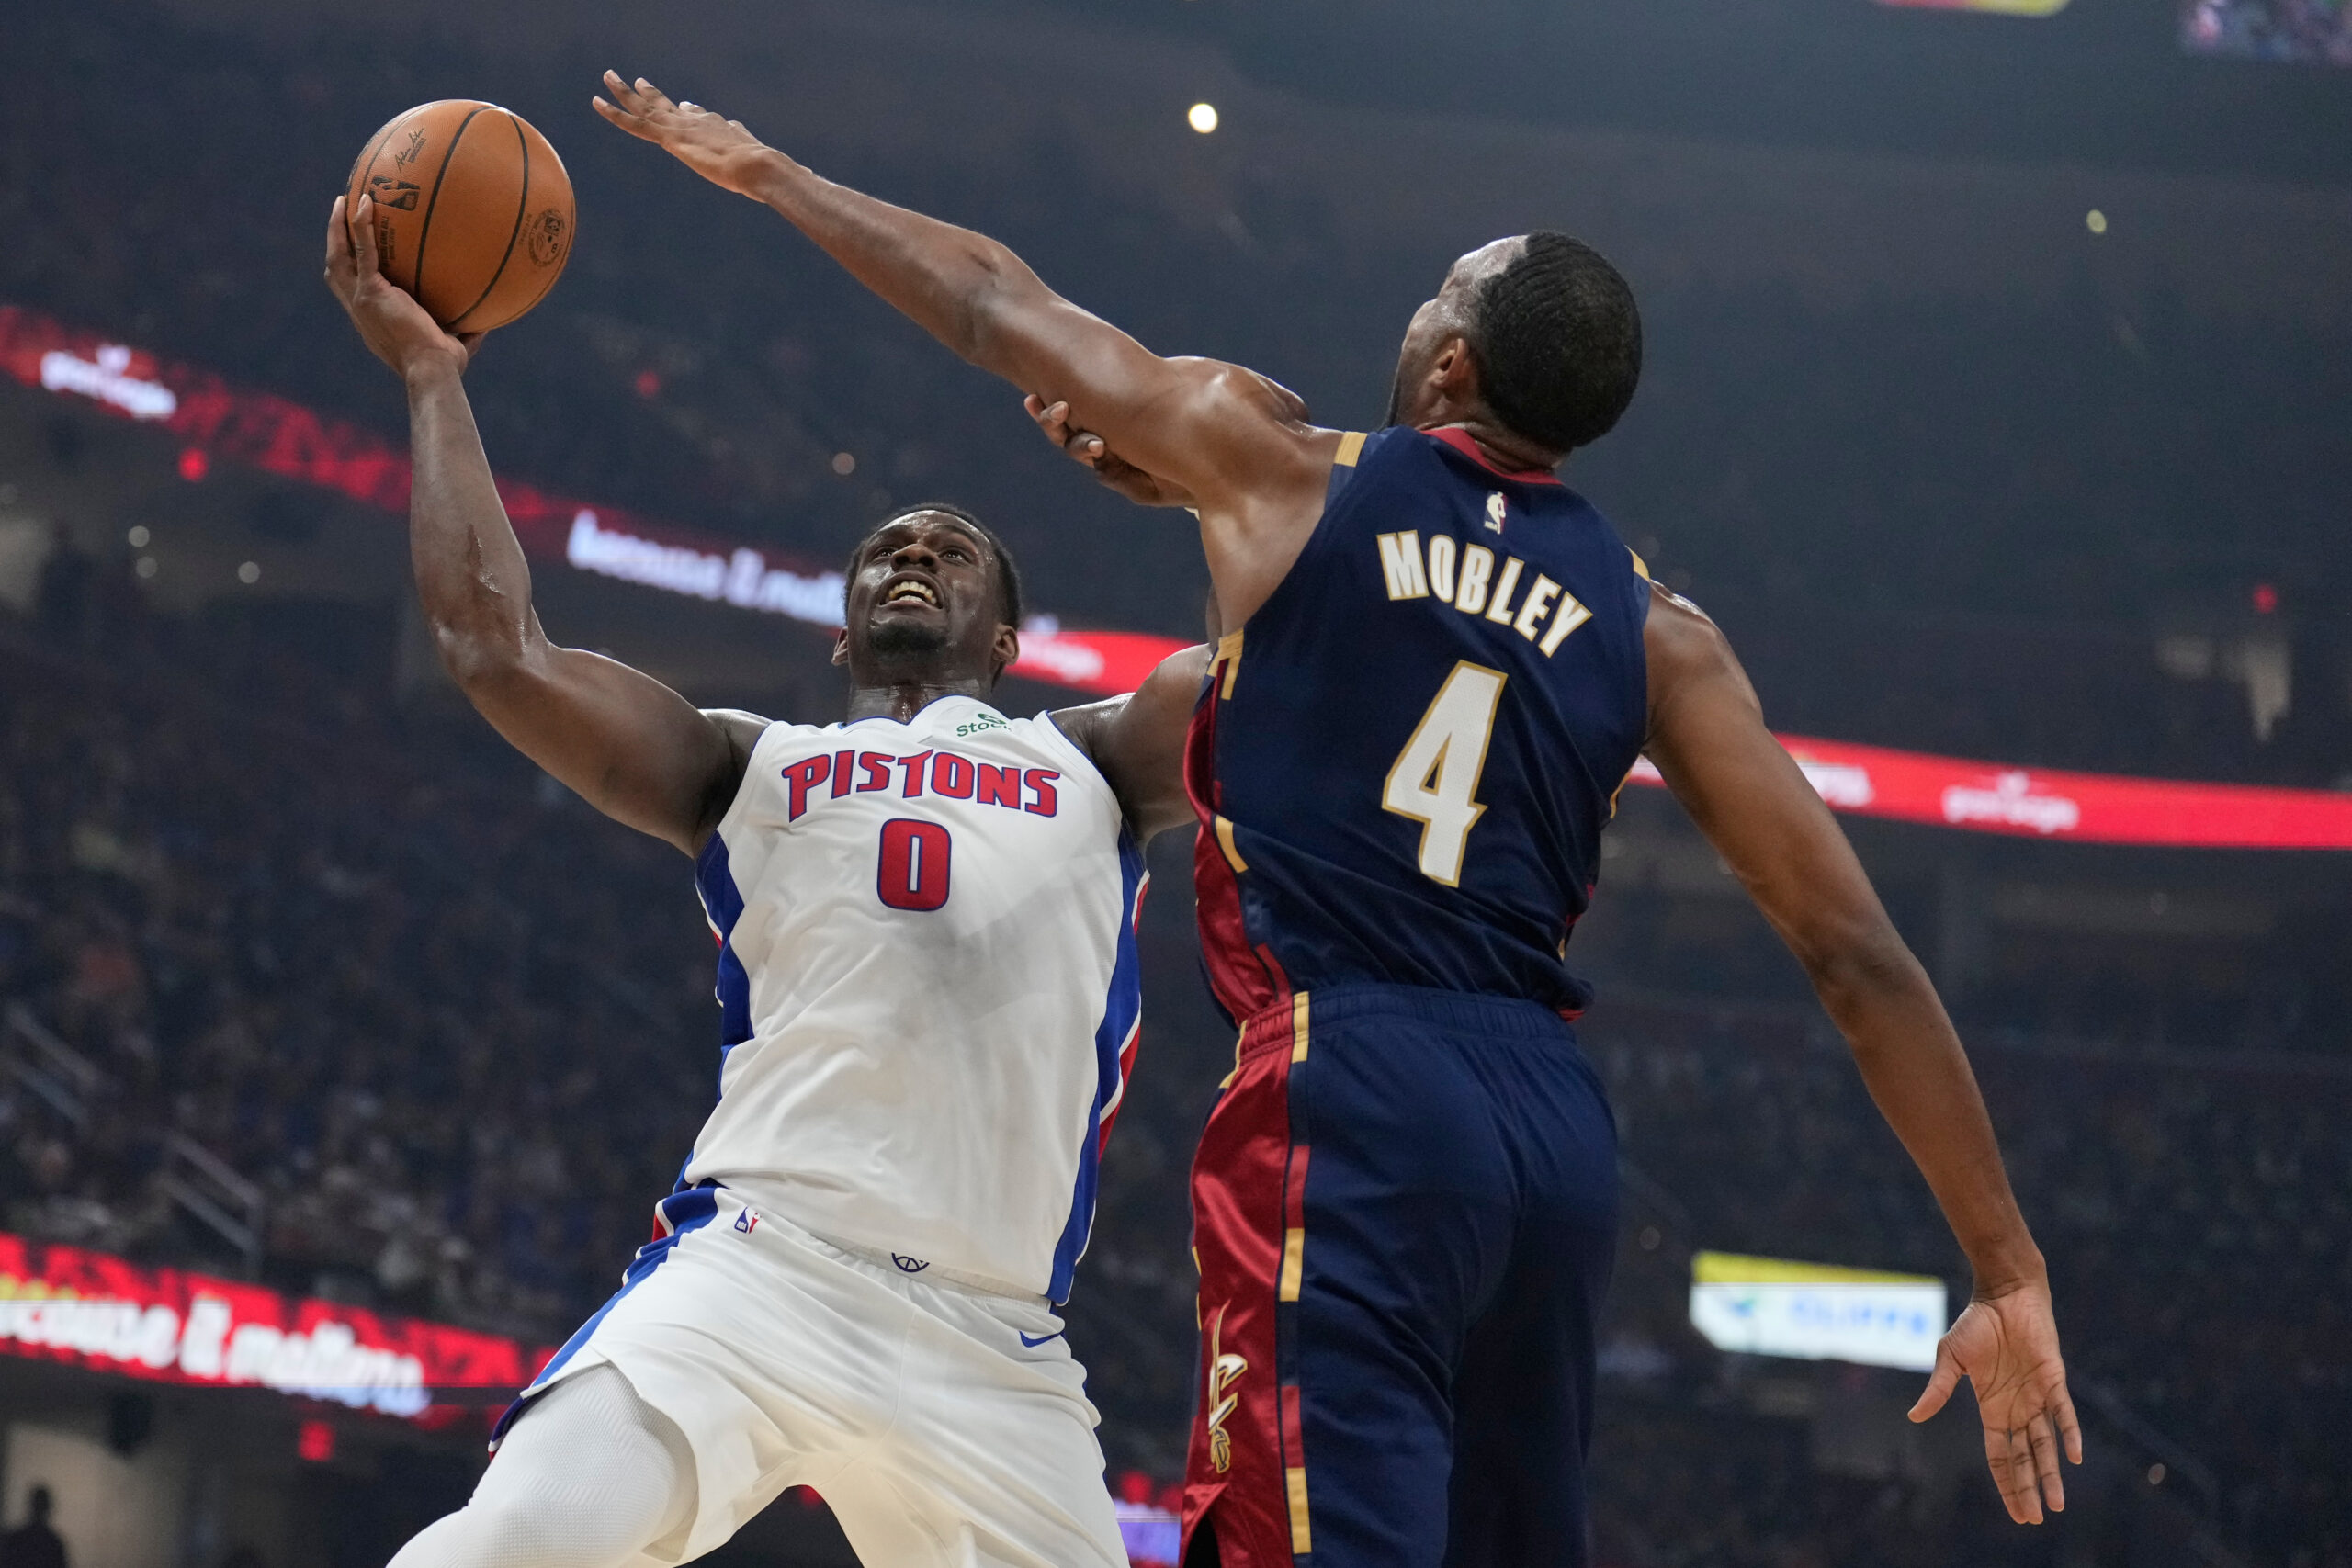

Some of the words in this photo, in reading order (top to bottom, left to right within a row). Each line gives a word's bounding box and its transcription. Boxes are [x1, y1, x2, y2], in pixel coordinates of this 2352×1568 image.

[1376, 530, 1593, 658] MOBLEY
[782, 749, 1060, 822] PISTONS
[1381, 660, 1509, 887] 4
[877, 818, 952, 911] 0
